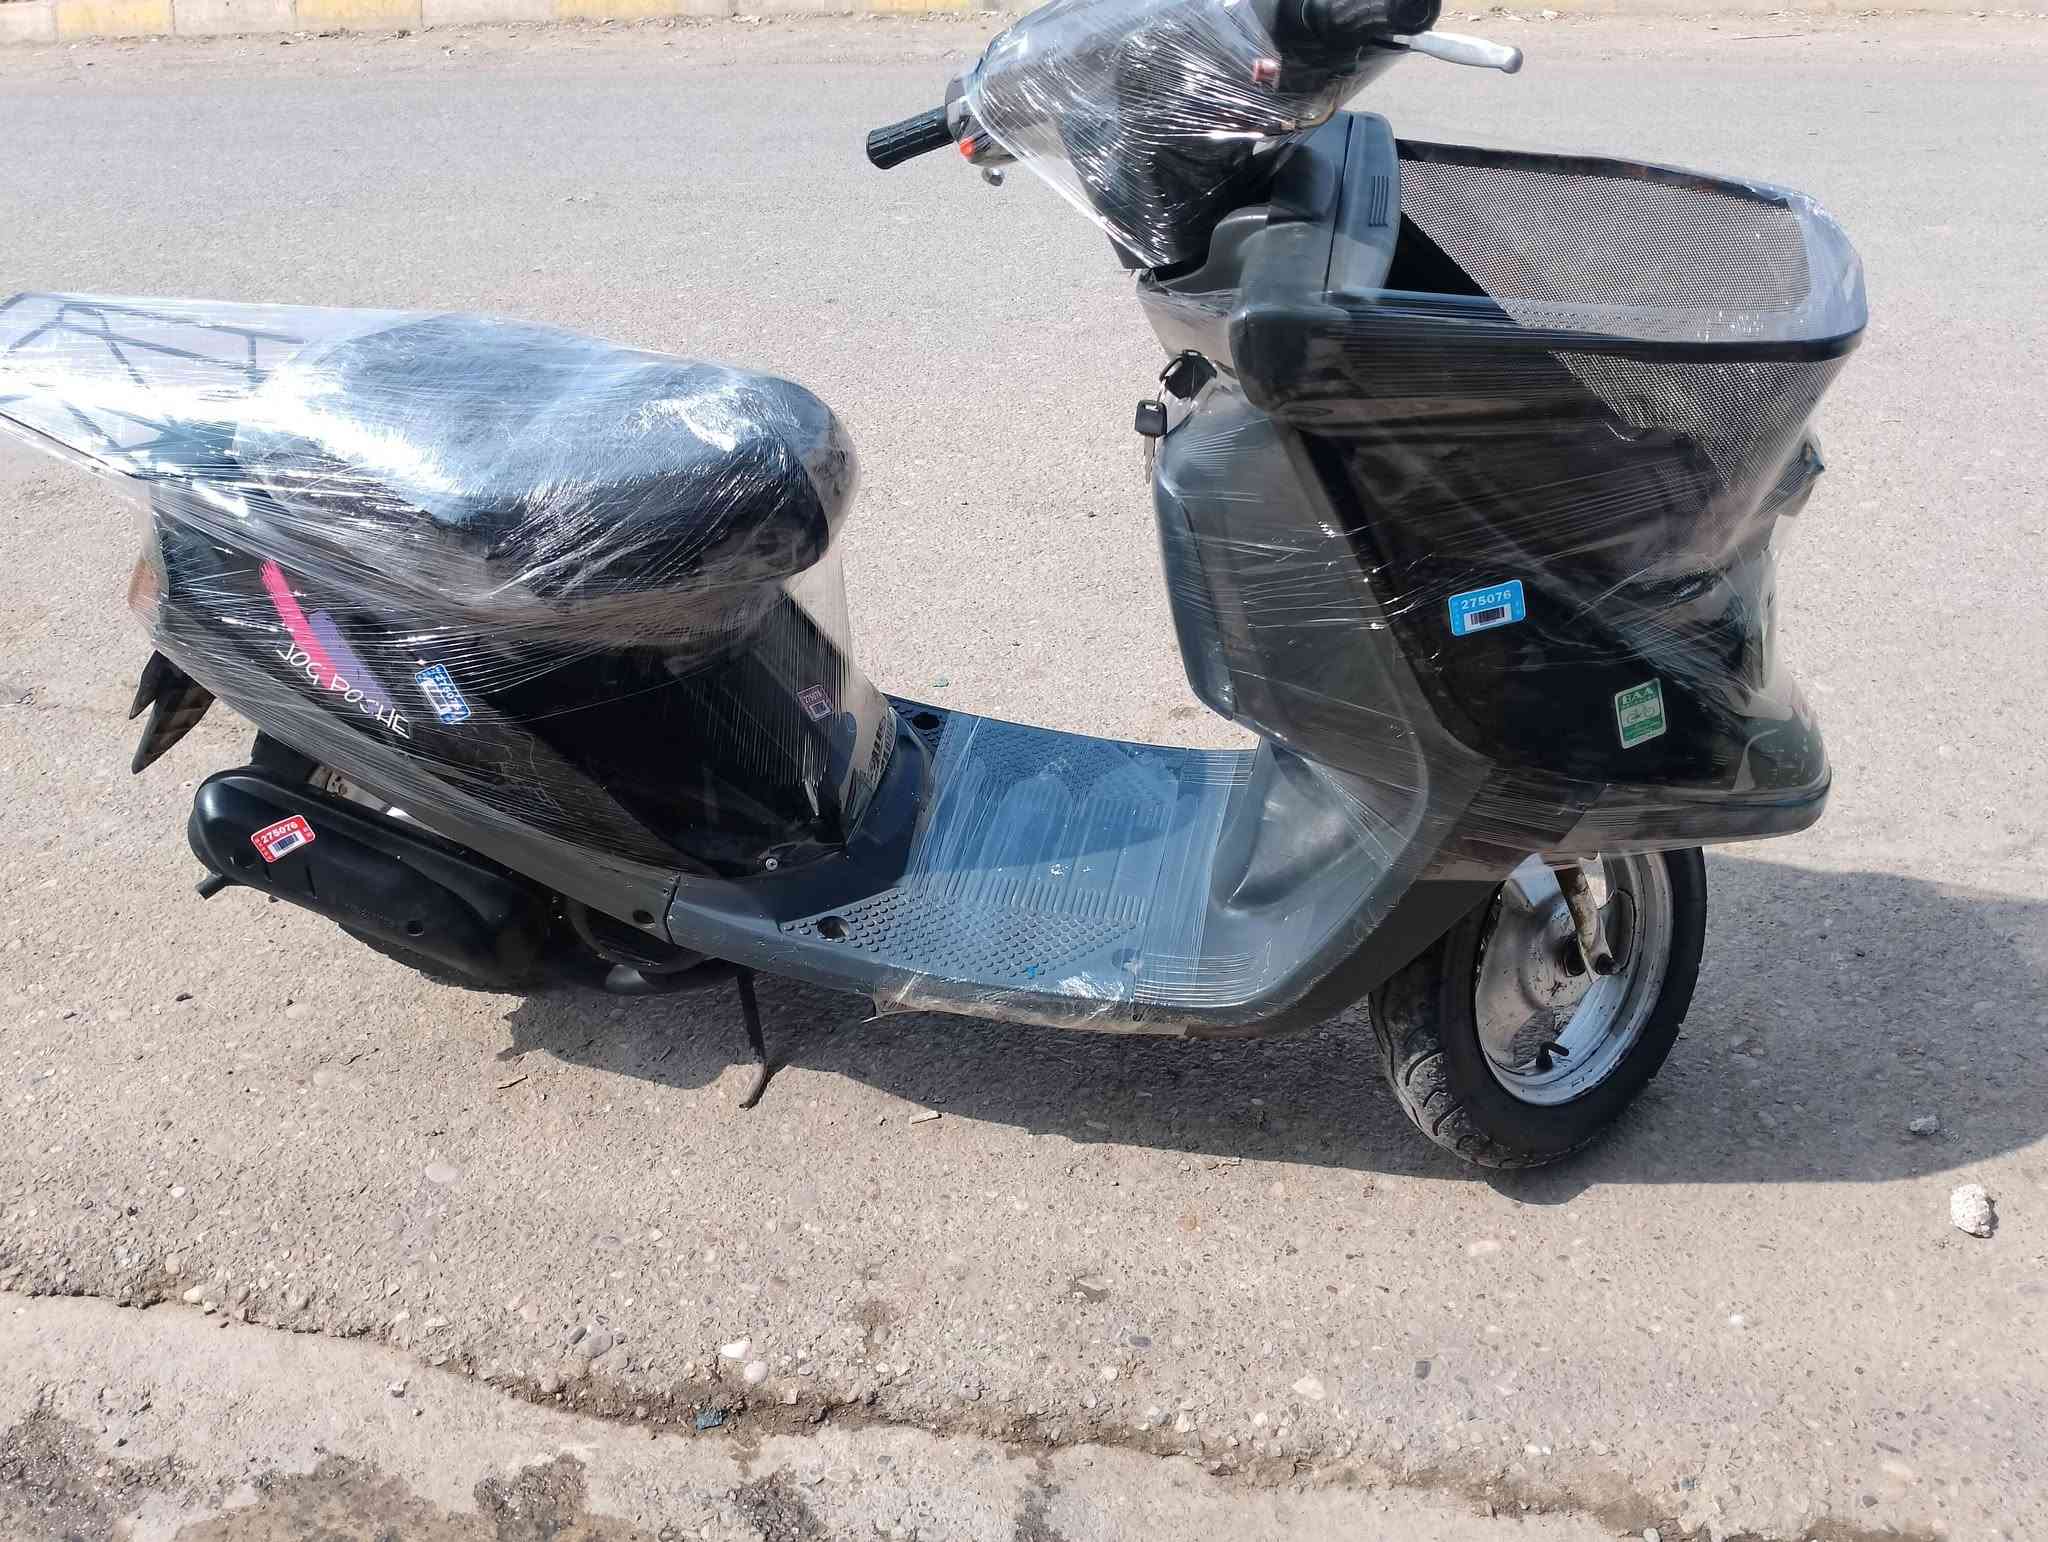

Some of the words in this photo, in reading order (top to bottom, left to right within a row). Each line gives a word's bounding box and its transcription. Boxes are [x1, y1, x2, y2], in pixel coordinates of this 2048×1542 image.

[1461, 589, 1512, 610] 275076
[275, 643, 323, 686] JOG
[261, 821, 299, 844] 275076
